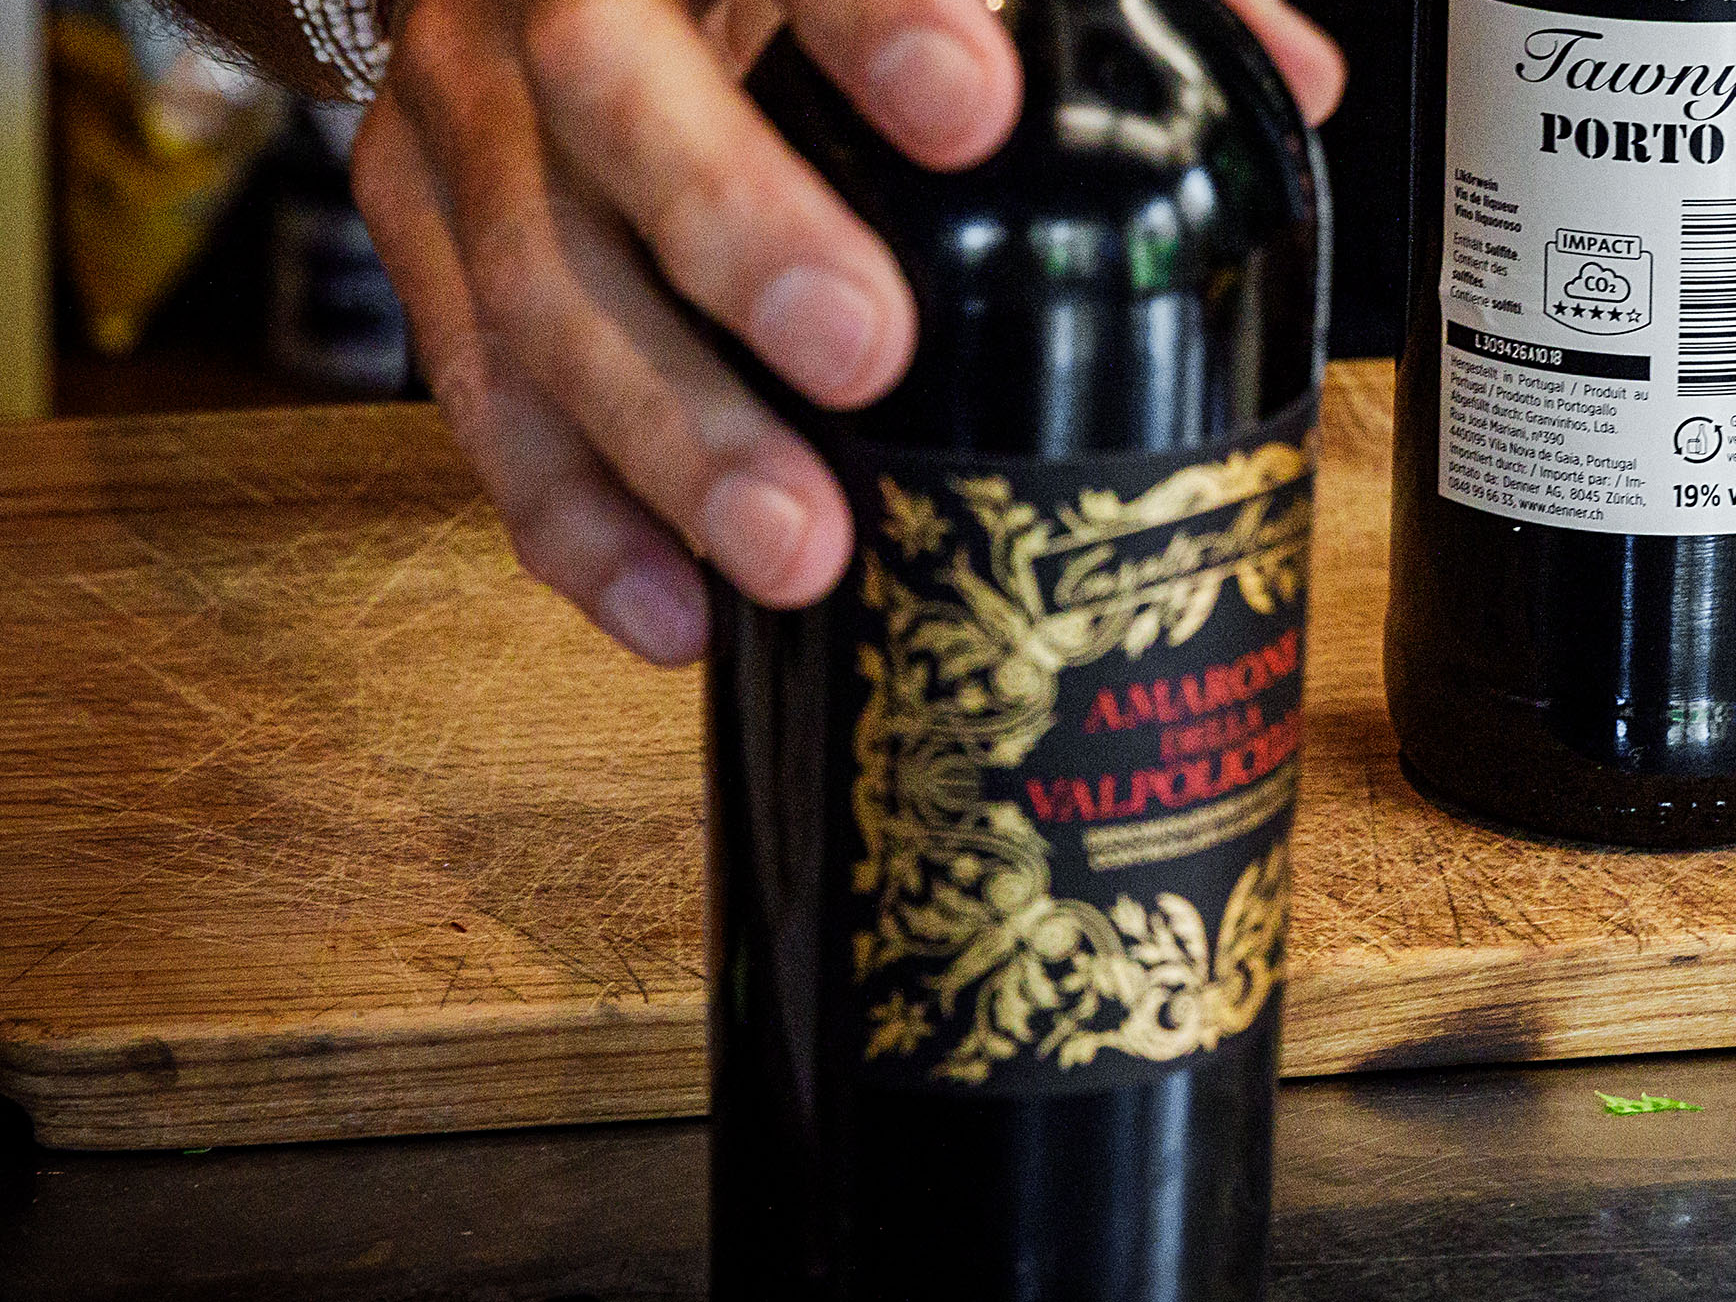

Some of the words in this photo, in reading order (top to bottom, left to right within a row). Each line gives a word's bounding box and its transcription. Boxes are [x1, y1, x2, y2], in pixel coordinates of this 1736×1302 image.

[1539, 111, 1726, 165] PORTO
[1563, 233, 1636, 255] IMPACT
[1503, 369, 1514, 383] in
[1518, 373, 1566, 394] Portugal
[1583, 383, 1627, 400] Produit
[1633, 390, 1650, 401] au
[1496, 386, 1541, 407] Prodotto
[1543, 396, 1555, 409] in
[1557, 398, 1618, 417] Portogallo
[1593, 420, 1619, 435] Lda.
[1487, 437, 1508, 453] Vila
[1509, 442, 1535, 459] Nova
[1537, 448, 1553, 462] de
[1554, 450, 1584, 468] Gaia,
[1586, 454, 1638, 472] Portugal
[1448, 460, 1481, 481] portato
[1502, 475, 1541, 495] Denner
[1545, 484, 1565, 501] AG,
[1569, 487, 1601, 503] 8045
[1605, 491, 1647, 508] Zürich,
[1539, 465, 1585, 484] Importé
[1587, 475, 1612, 487] par:
[1625, 476, 1647, 489] Im-
[1471, 483, 1486, 500] 99
[1486, 489, 1500, 503] 66
[1501, 492, 1518, 509] 33,
[1519, 498, 1605, 521] www.denner.ch
[1672, 482, 1722, 509] 19%
